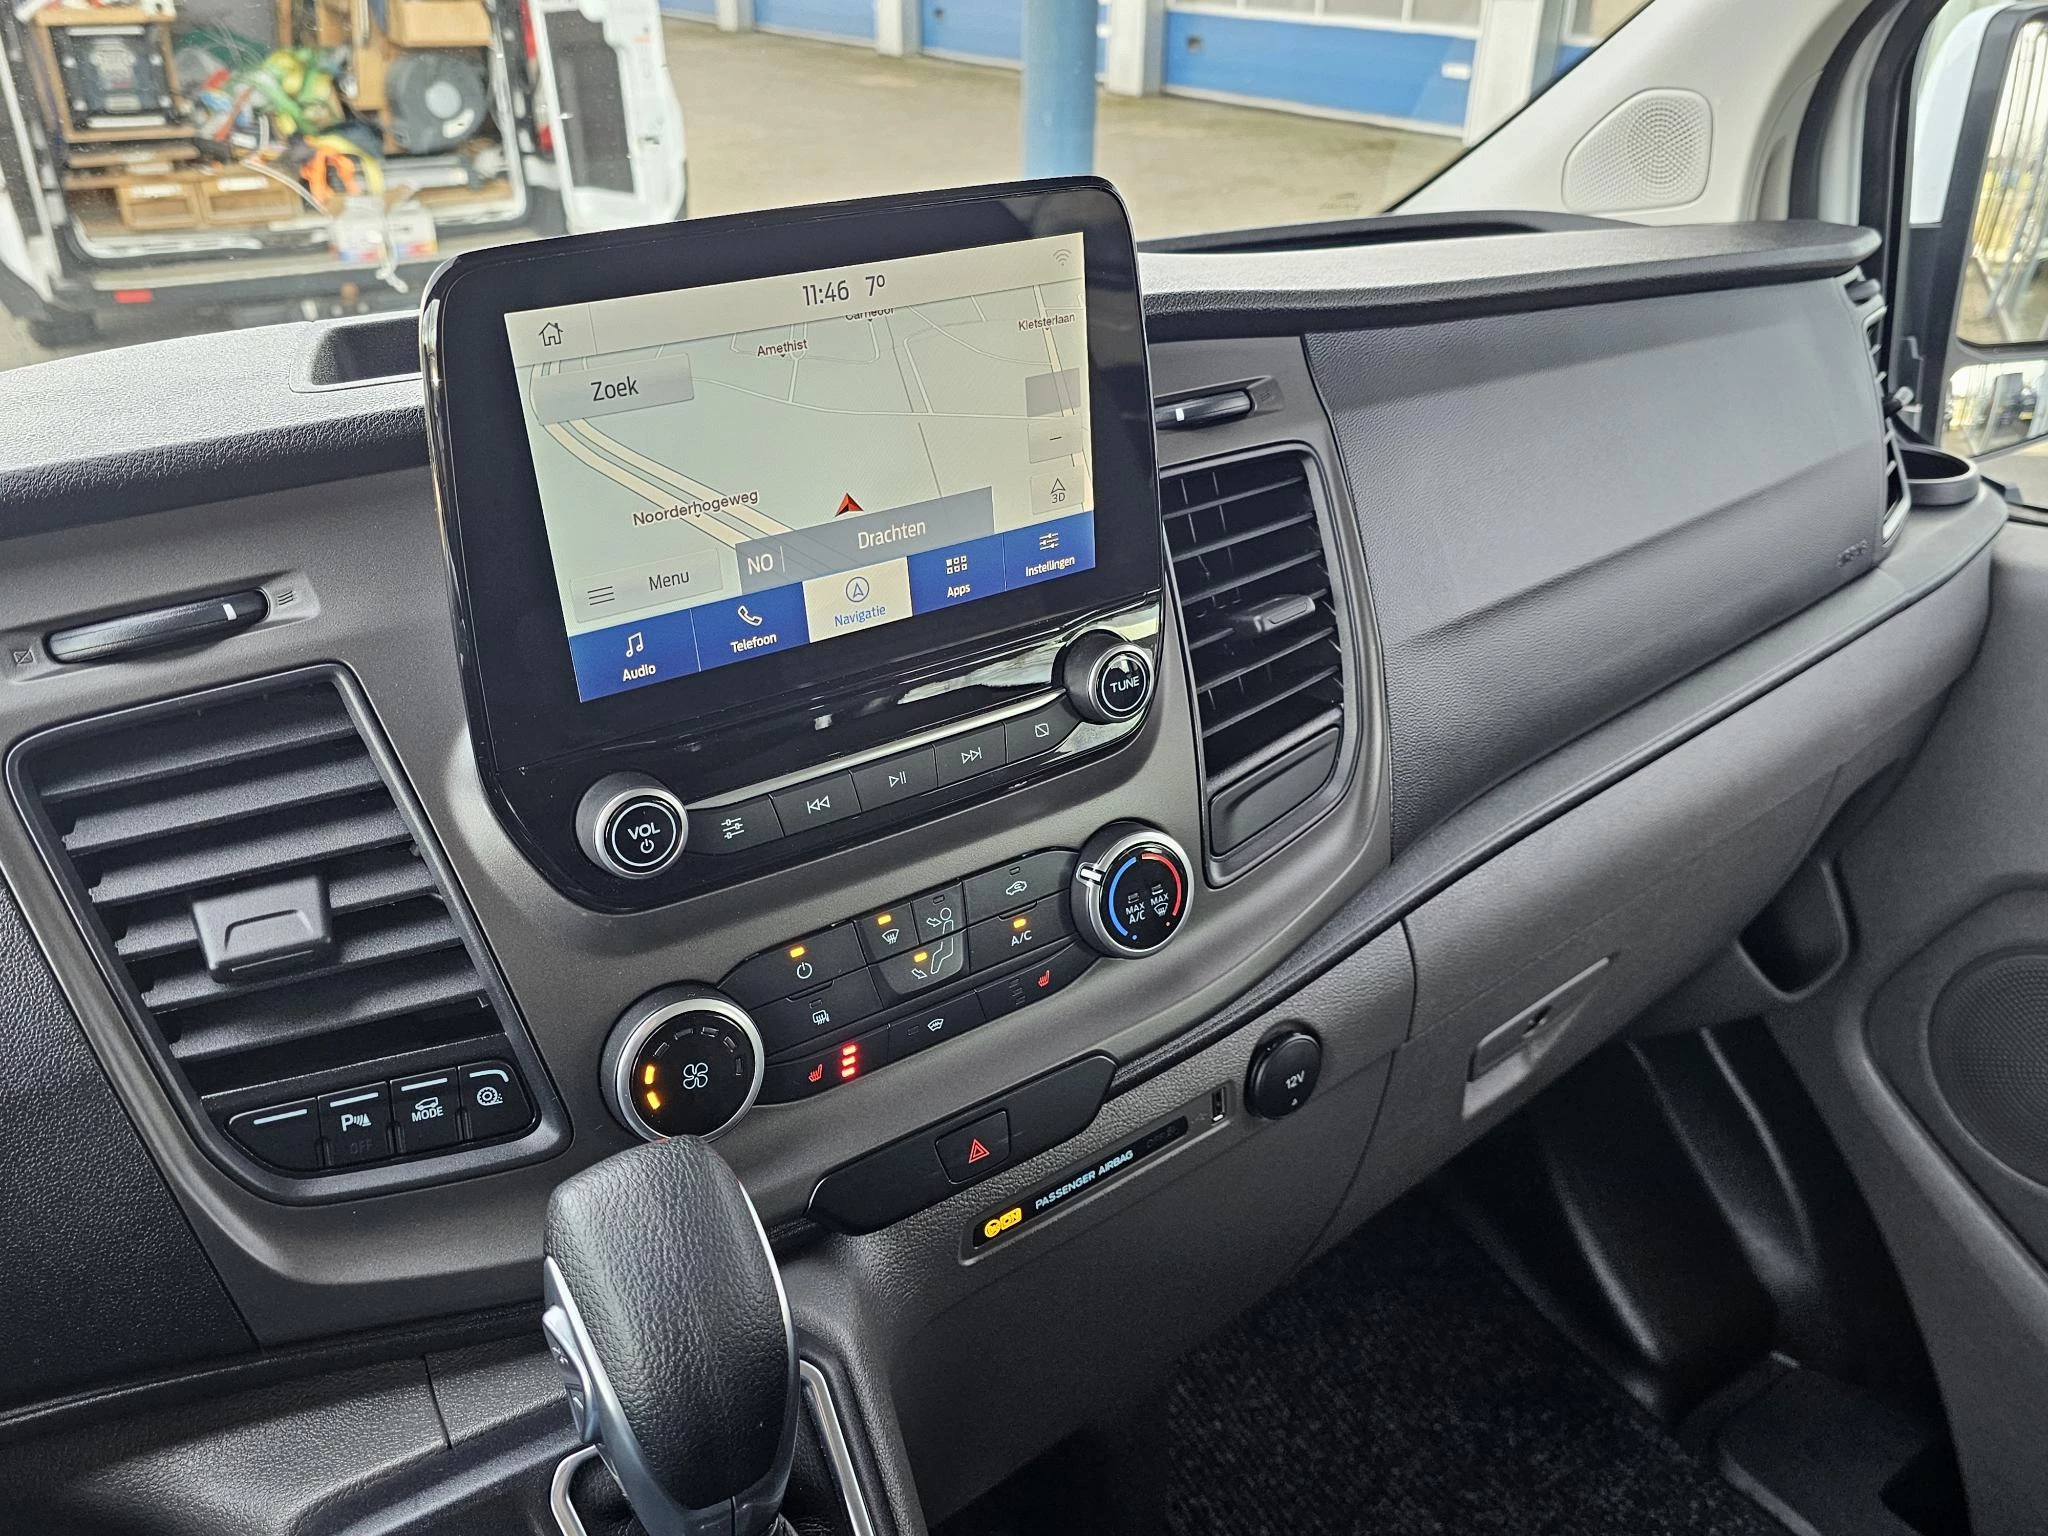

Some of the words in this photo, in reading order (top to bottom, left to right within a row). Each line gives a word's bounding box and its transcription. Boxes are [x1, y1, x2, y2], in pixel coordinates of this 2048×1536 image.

[803, 280, 849, 306] 11:46
[1018, 313, 1076, 331] Kletsterlaan
[757, 339, 808, 357] Amethist
[591, 376, 639, 401] Zoek
[1051, 492, 1066, 504] 3D
[633, 491, 759, 526] Noorderhogeweg
[747, 553, 774, 575] NO
[858, 521, 926, 550] Drachten
[1025, 556, 1076, 577] Instellingen
[649, 571, 690, 591] Menu
[947, 583, 971, 598] Apps
[834, 605, 886, 628] Navigatie
[730, 633, 777, 654] Telefoon
[622, 664, 657, 682] Audio
[1110, 675, 1140, 693] TUNE
[627, 822, 661, 840] VOL
[1125, 901, 1145, 915] MAX
[1150, 892, 1169, 906] MAX
[1128, 911, 1146, 925] A/C
[1011, 930, 1033, 947] A/C
[1285, 1070, 1305, 1089] 12V
[411, 1106, 444, 1122] MODE
[1035, 1170, 1096, 1209] PASSENGER
[1098, 1150, 1134, 1176] AIRBAG
